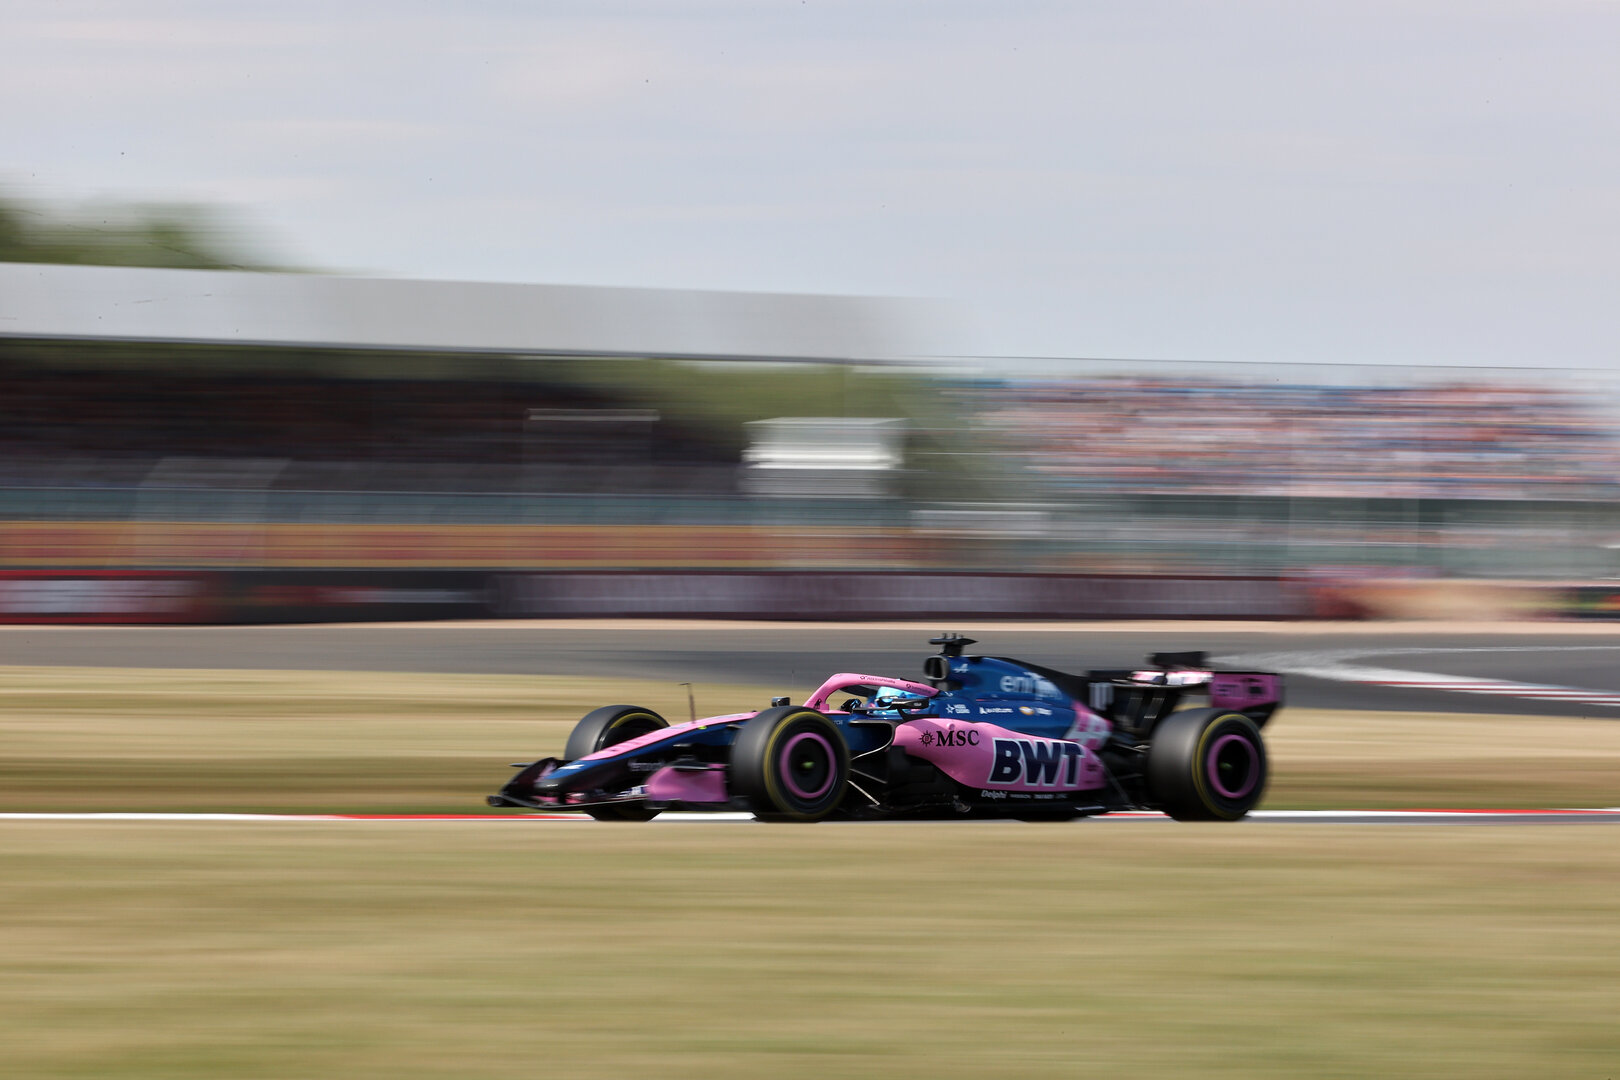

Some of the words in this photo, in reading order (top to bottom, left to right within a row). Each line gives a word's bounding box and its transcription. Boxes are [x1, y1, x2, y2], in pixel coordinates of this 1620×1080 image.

[936, 730, 980, 747] MSC
[987, 737, 1086, 787] BWT
[981, 790, 1007, 800] Delphi
